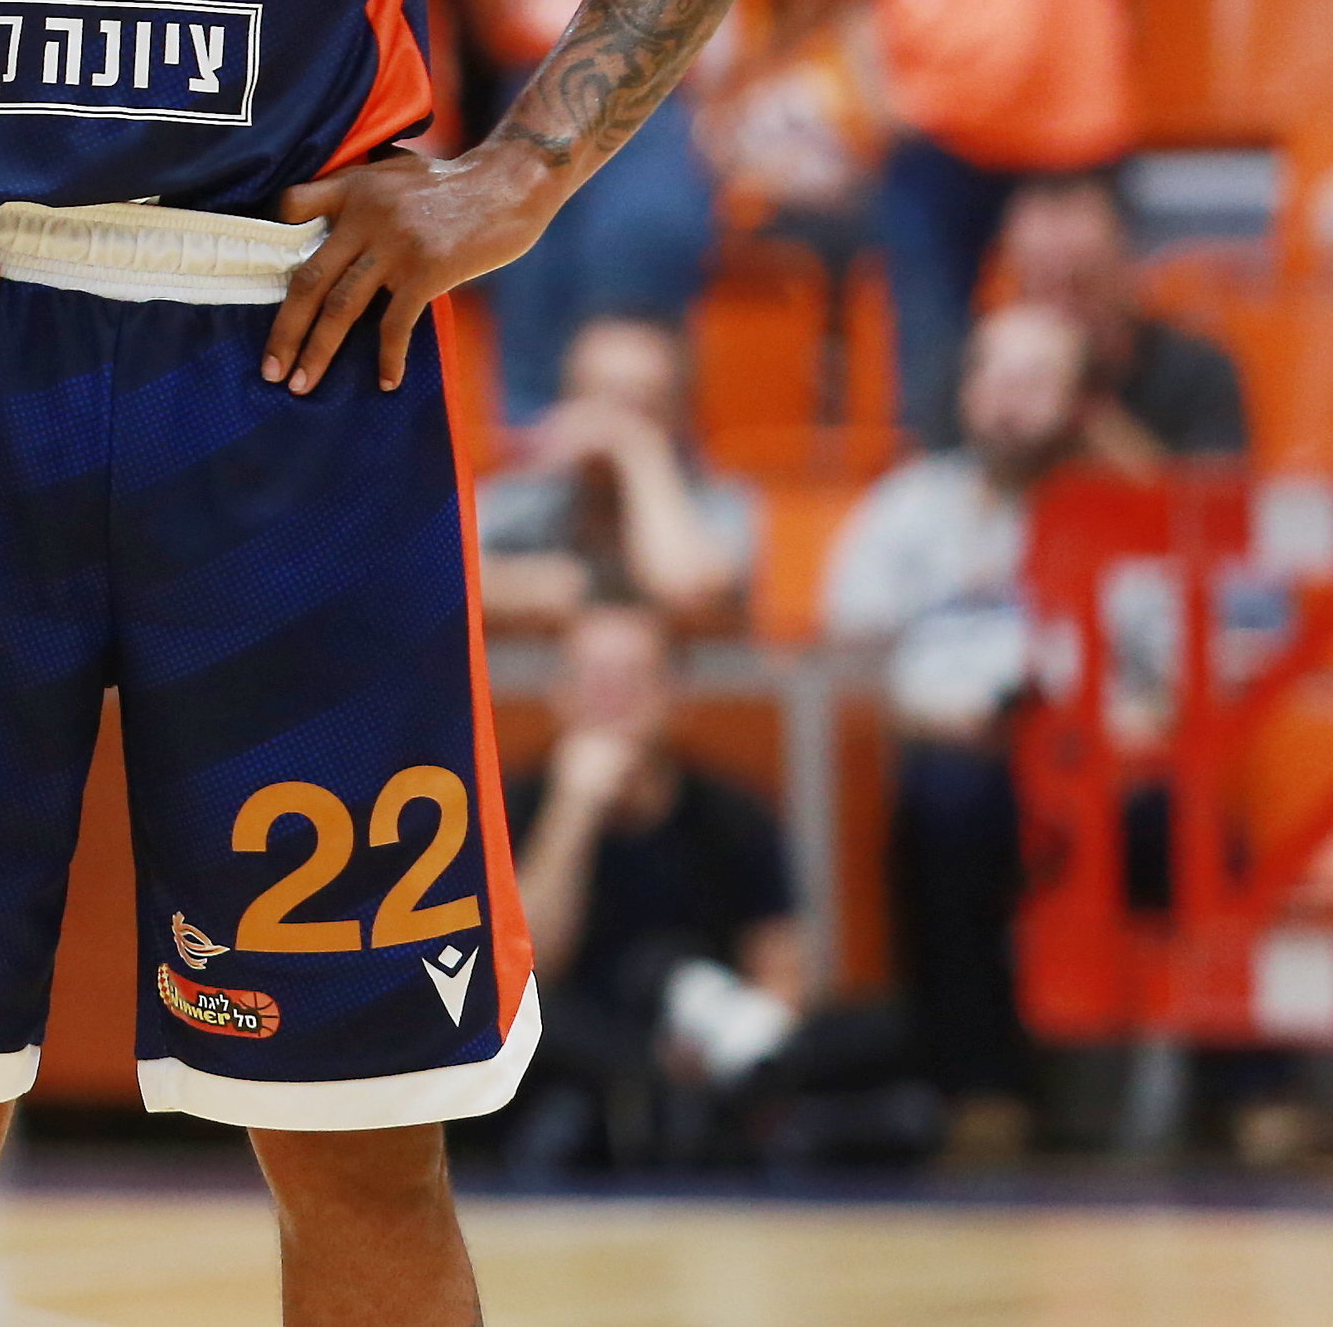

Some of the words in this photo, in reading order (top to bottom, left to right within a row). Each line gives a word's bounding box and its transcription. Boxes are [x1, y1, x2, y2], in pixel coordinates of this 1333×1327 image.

[42, 17, 226, 94] ציונה
[231, 765, 483, 953] 22
[198, 993, 229, 1012] ליגת
[233, 1008, 258, 1029] סל
